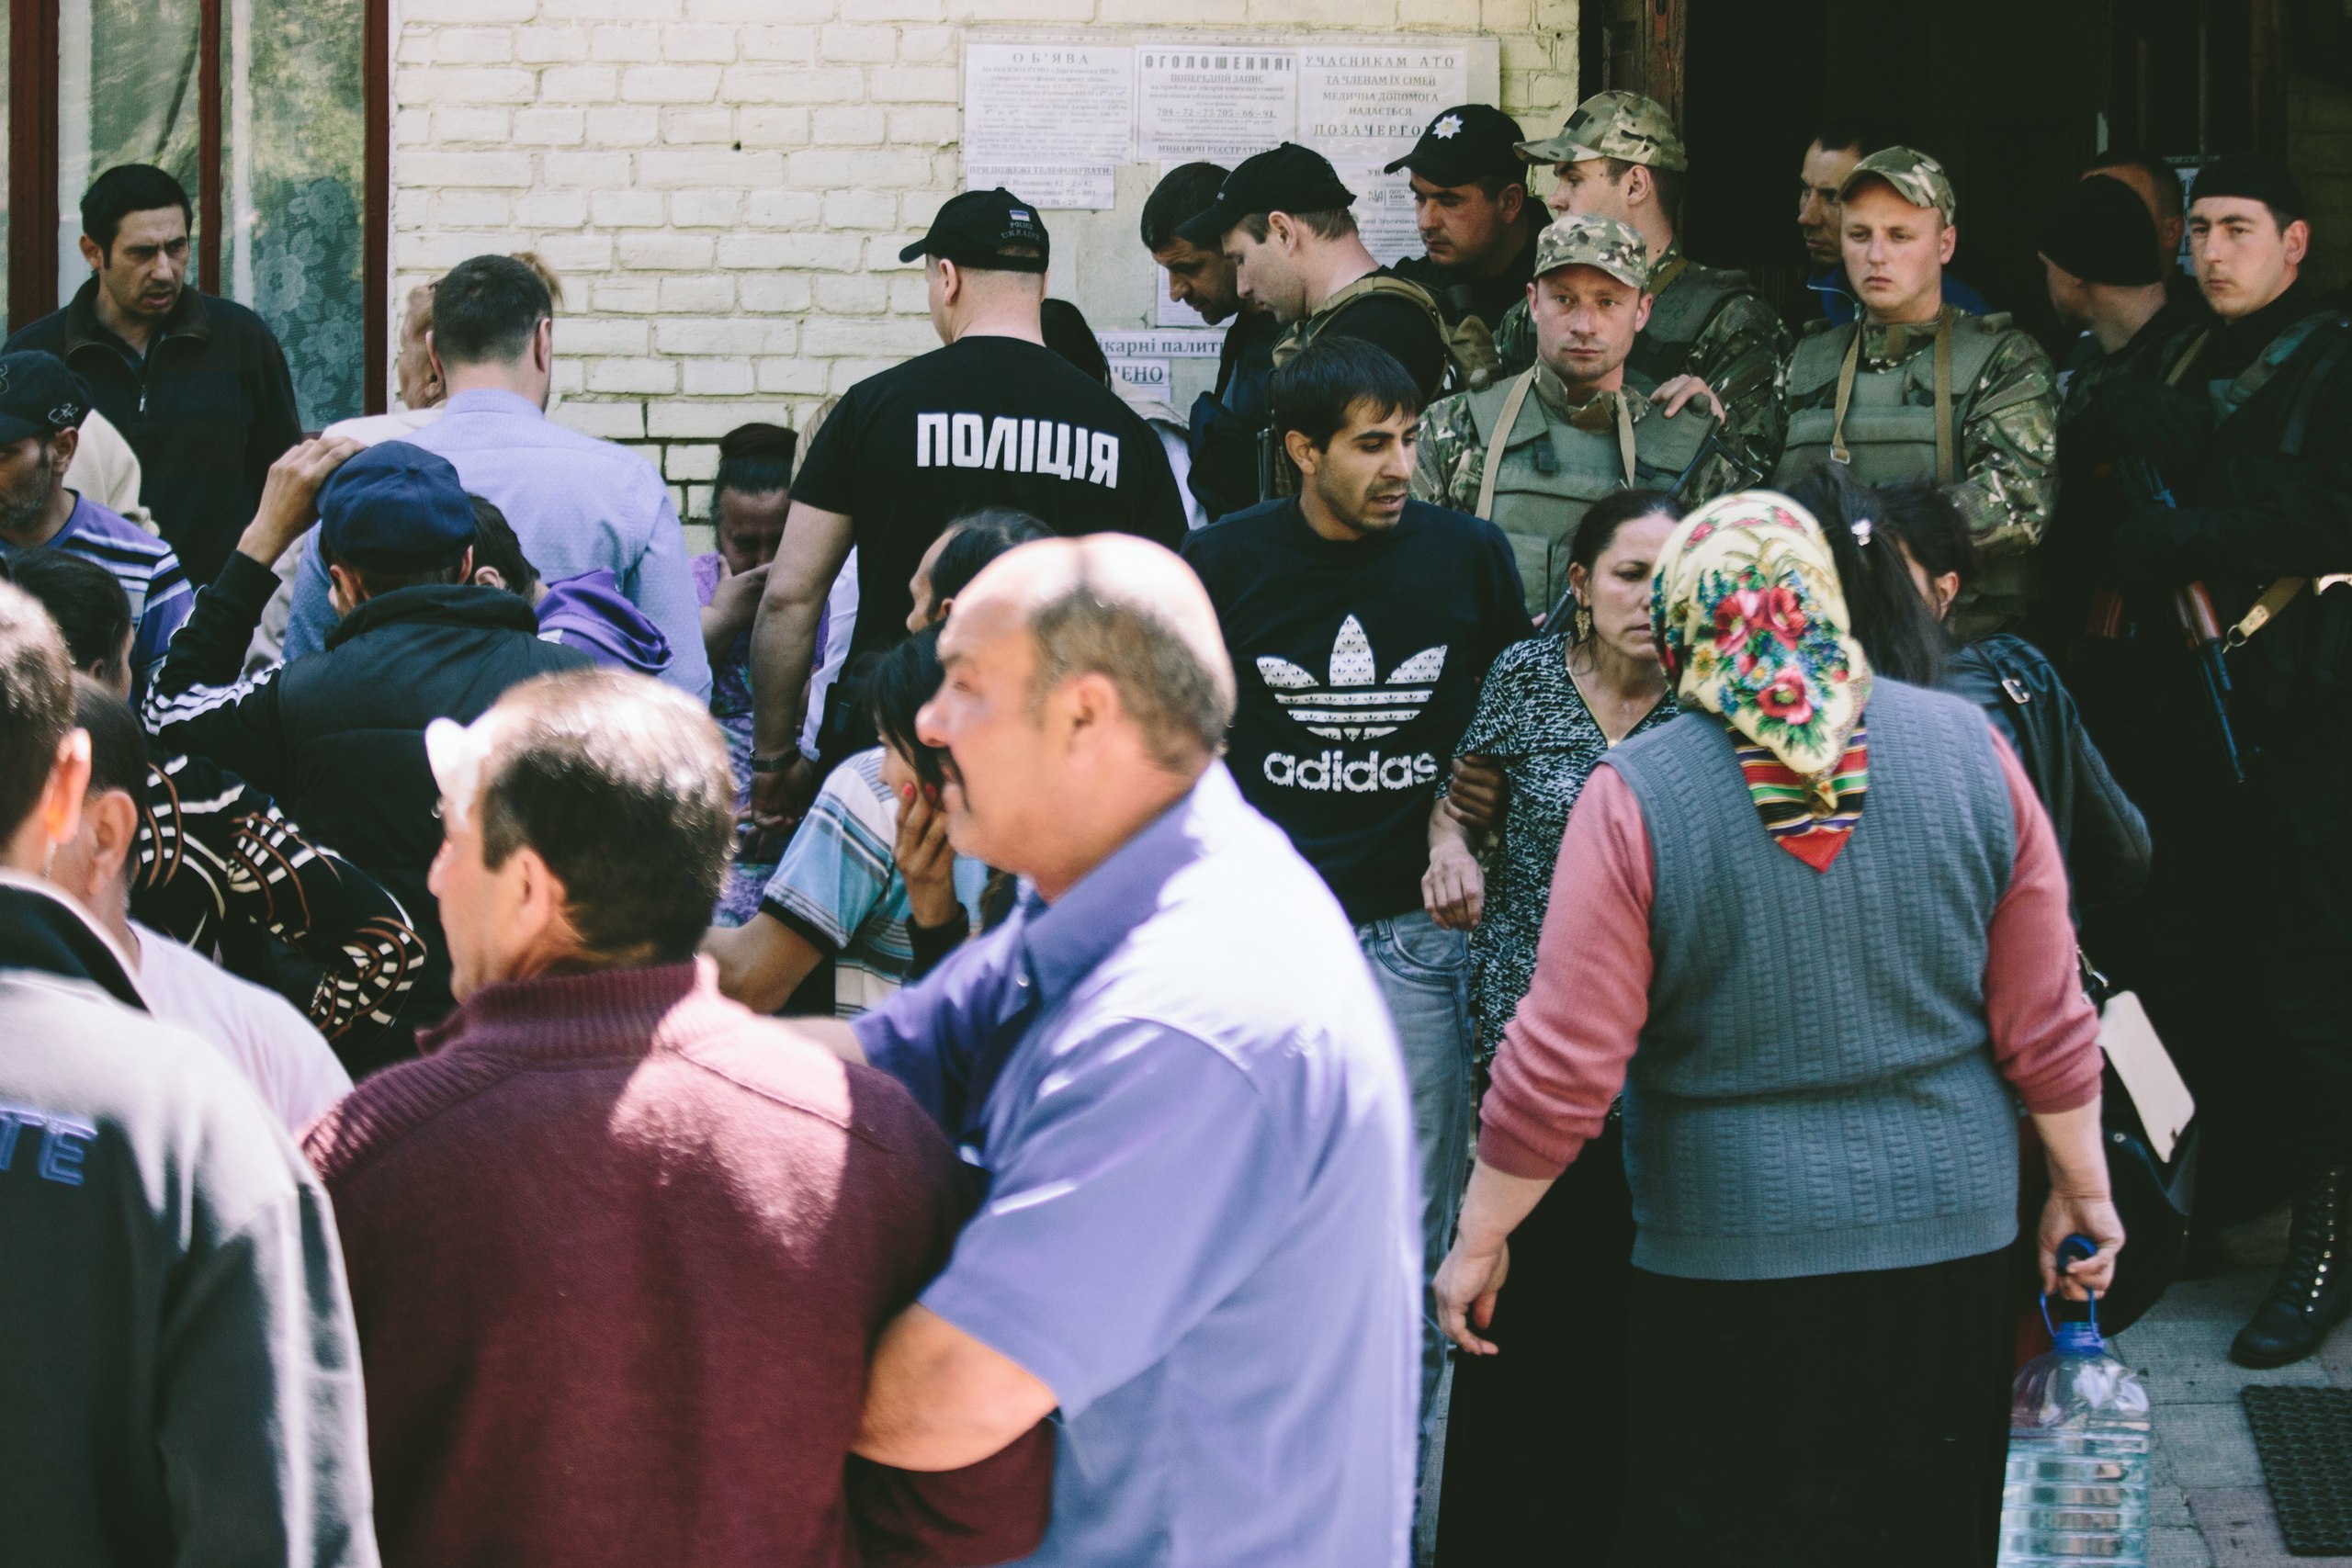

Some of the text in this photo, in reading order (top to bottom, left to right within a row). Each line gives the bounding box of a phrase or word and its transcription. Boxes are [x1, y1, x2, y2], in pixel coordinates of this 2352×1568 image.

[1012, 52, 1088, 64] ОБ'ЯВА
[1145, 54, 1290, 71] ОГОЛОШЕННЯ!
[1306, 56, 1454, 68] УЧАСНИКАМ АТО
[1170, 73, 1264, 85] ПОПЕРЕДНІЙ ЗАПИС
[1325, 74, 1436, 86] ТА ЧЛЕНАМ ЇХ СІМЕЙ
[1322, 92, 1439, 103] МЕДИЧНА ДОПОМОГА
[1156, 107, 1173, 117] 704
[1183, 107, 1194, 117] 72
[1203, 108, 1215, 118] 75
[1216, 108, 1235, 118] 705
[1242, 109, 1255, 118] 66
[1262, 109, 1278, 119] 91.
[1349, 107, 1412, 117] НАДАЄТЬСЯ
[1314, 124, 1429, 137] ПОЗАЧЕРГО
[969, 165, 1112, 176] ПРИ ПОЖЕЖІ ТЕЛЕФОНУВАТИ:
[1010, 221, 1034, 231] POLICE
[1001, 228, 1041, 242] UKRAINE
[1114, 366, 1164, 383] ЕНО
[917, 412, 1119, 489] ПОЛІЦІЯ
[1263, 750, 1438, 793] adidas
